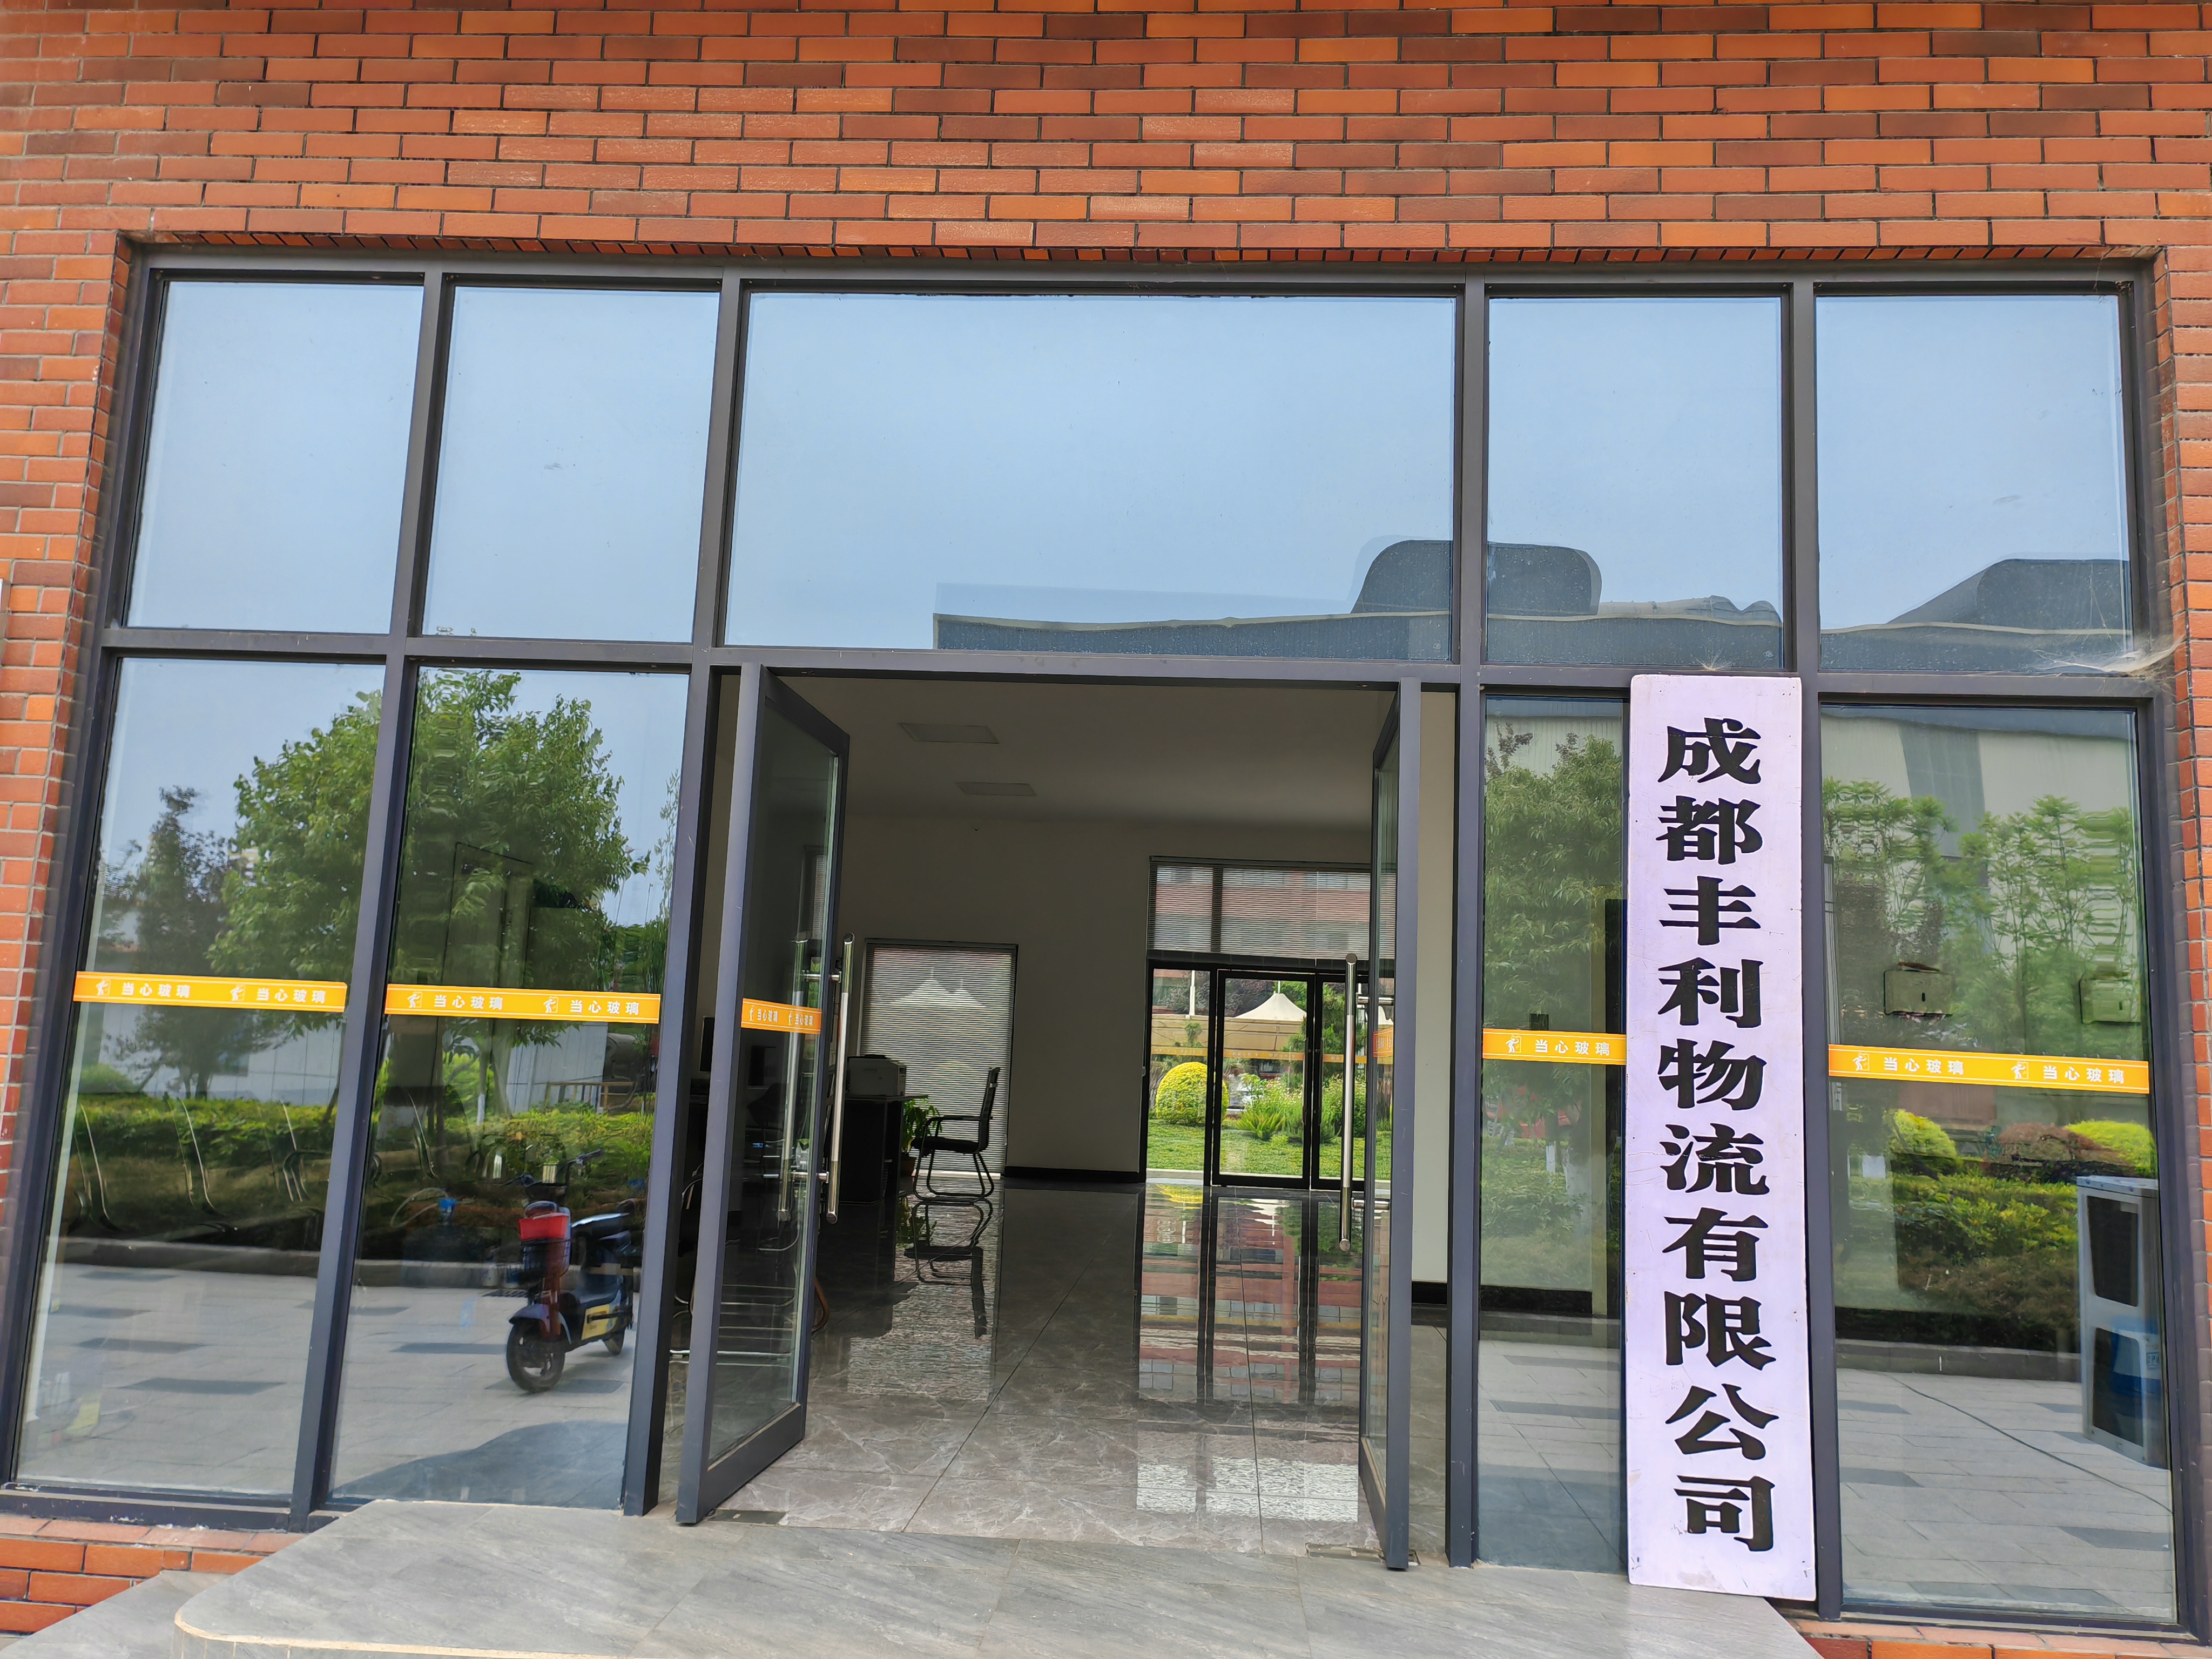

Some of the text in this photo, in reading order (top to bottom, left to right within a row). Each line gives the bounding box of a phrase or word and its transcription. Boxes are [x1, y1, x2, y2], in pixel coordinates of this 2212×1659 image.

[121, 982, 191, 999] 当心玻璃
[255, 987, 326, 1004] 当心玻璃
[434, 994, 504, 1010] 当心玻璃
[570, 999, 640, 1016] 当心玻璃
[1535, 1039, 1610, 1056] 当心玻璃
[1883, 1056, 1965, 1075] 当心玻璃
[2042, 1065, 2125, 1084] 当心玻璃
[1655, 717, 1779, 1552] 成都丰利物流有限公司
